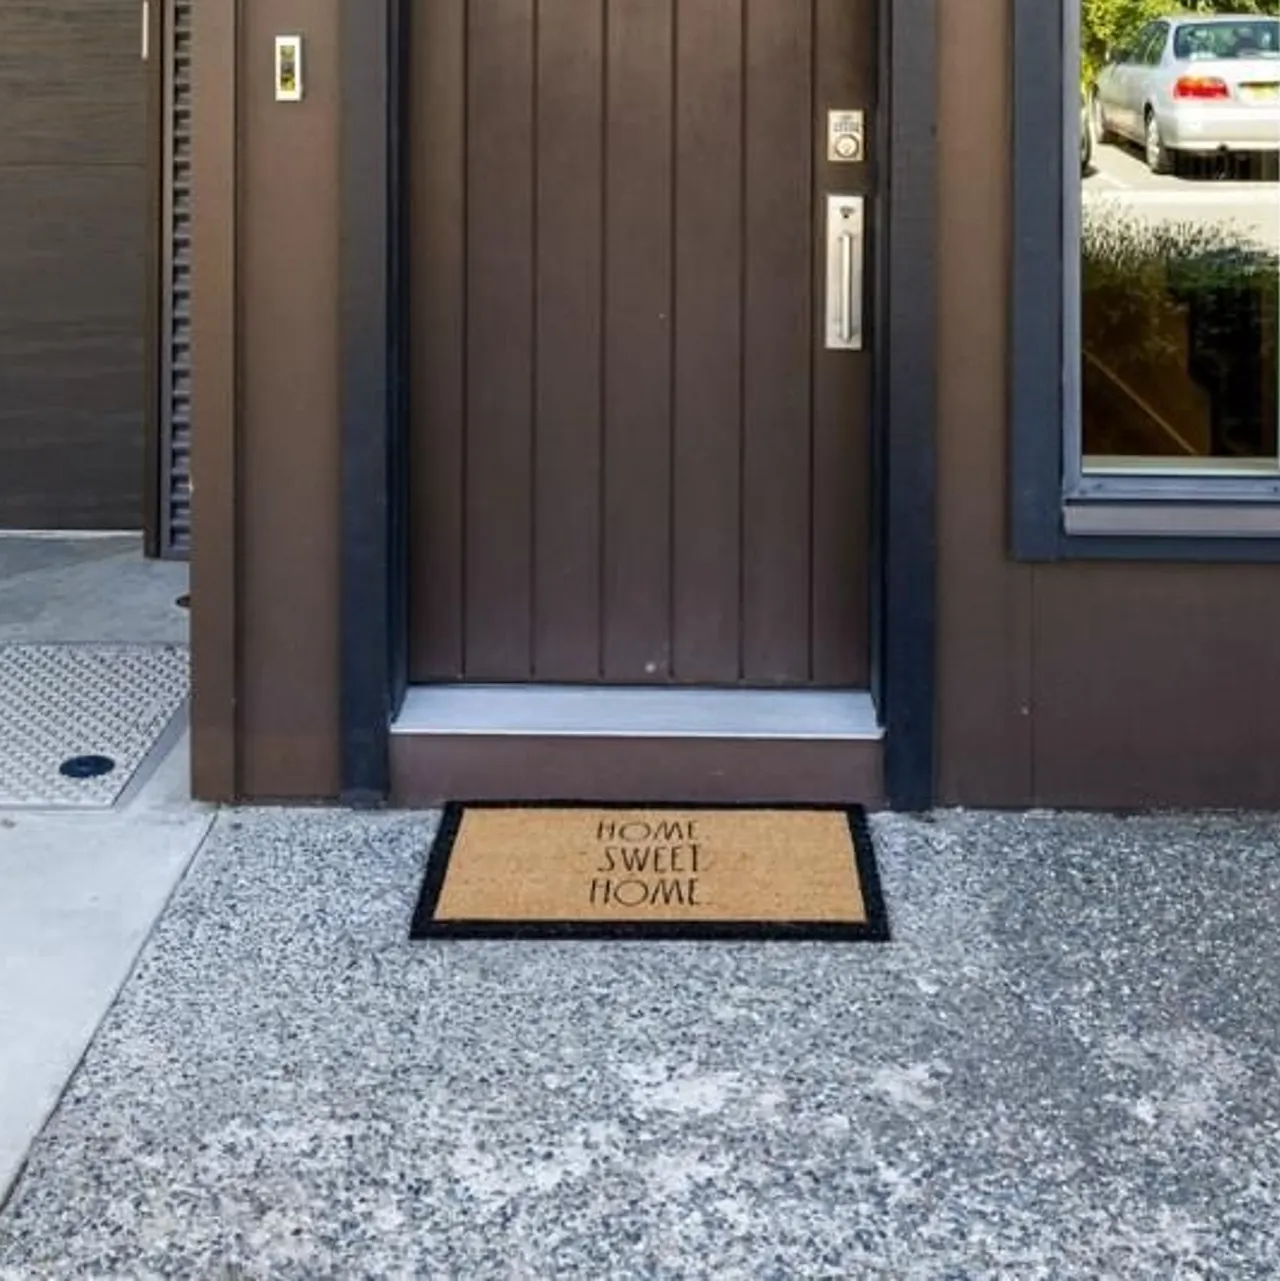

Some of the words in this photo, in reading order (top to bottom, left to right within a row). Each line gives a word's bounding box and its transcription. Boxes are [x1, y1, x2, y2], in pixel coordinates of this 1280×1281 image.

[597, 820, 699, 841] HOME
[597, 844, 701, 872] SWEET
[589, 878, 701, 907] HOME
